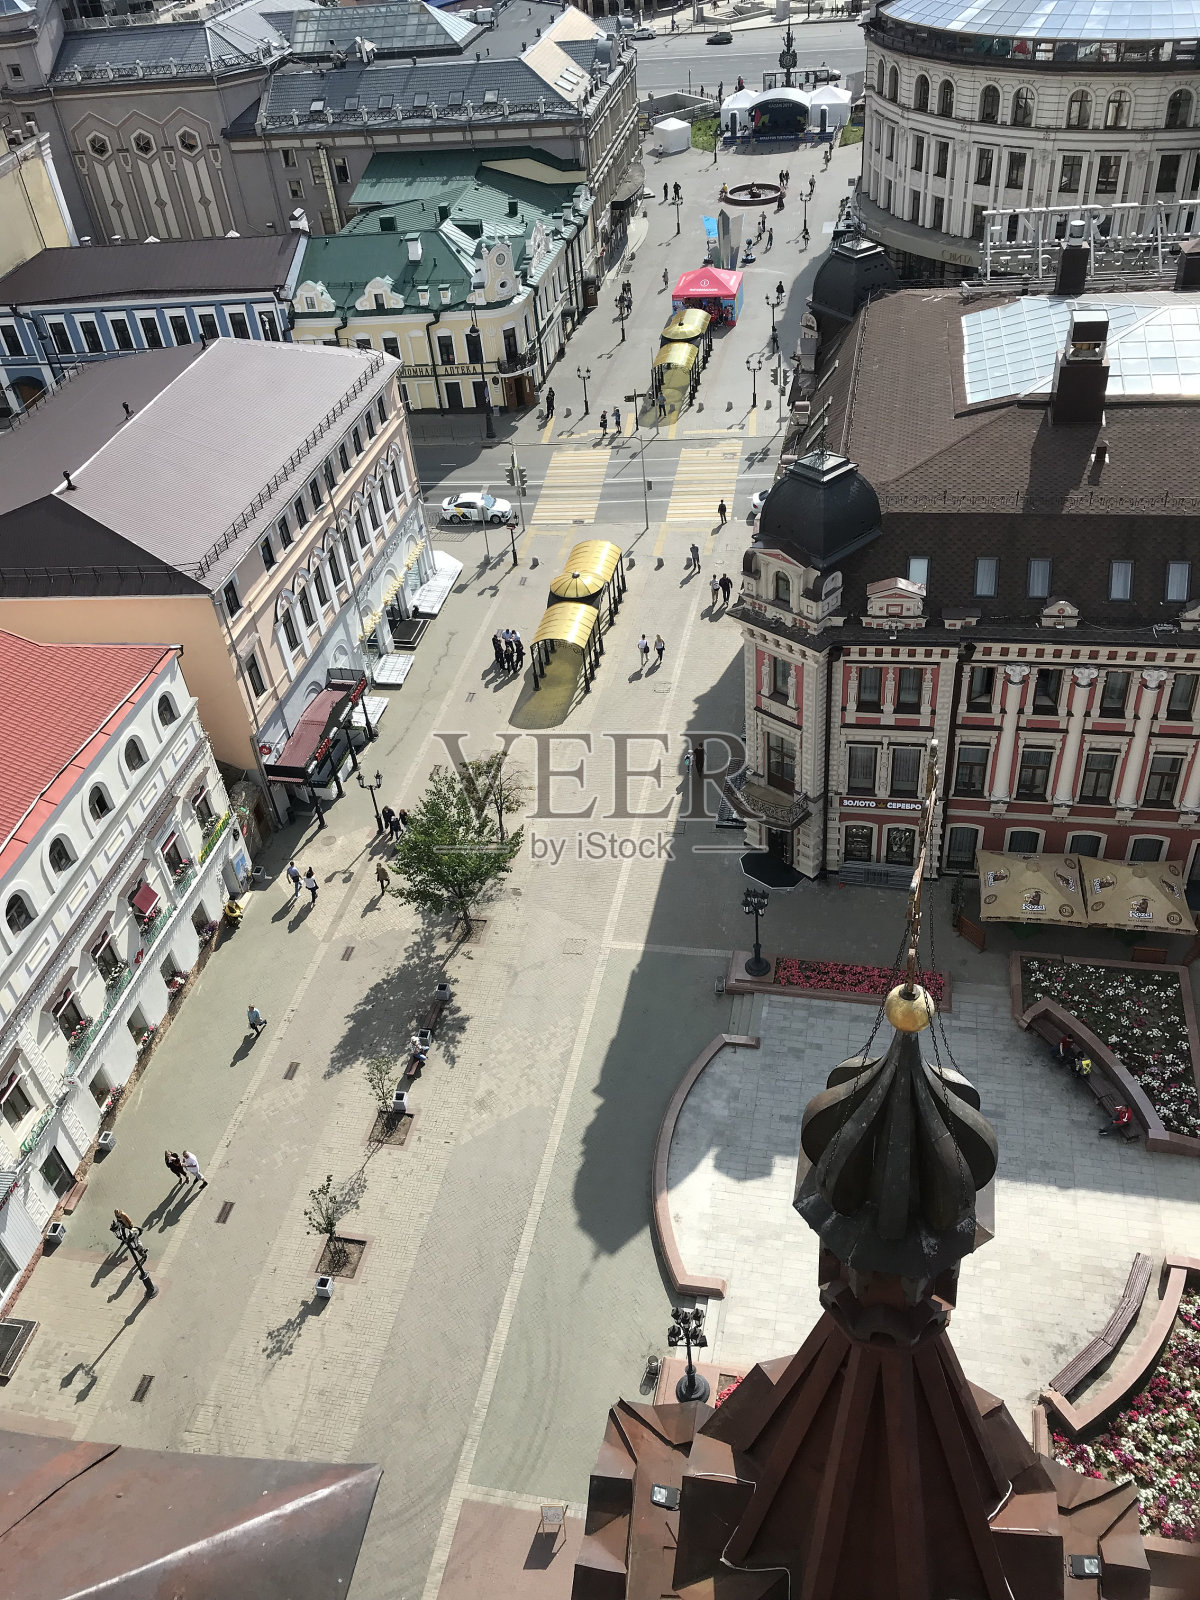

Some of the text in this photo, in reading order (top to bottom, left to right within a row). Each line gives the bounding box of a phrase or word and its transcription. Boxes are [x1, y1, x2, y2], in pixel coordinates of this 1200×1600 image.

[444, 365, 477, 375] АПТЕКА
[843, 799, 921, 810] ЗОЛОТО СЕРЕБРО
